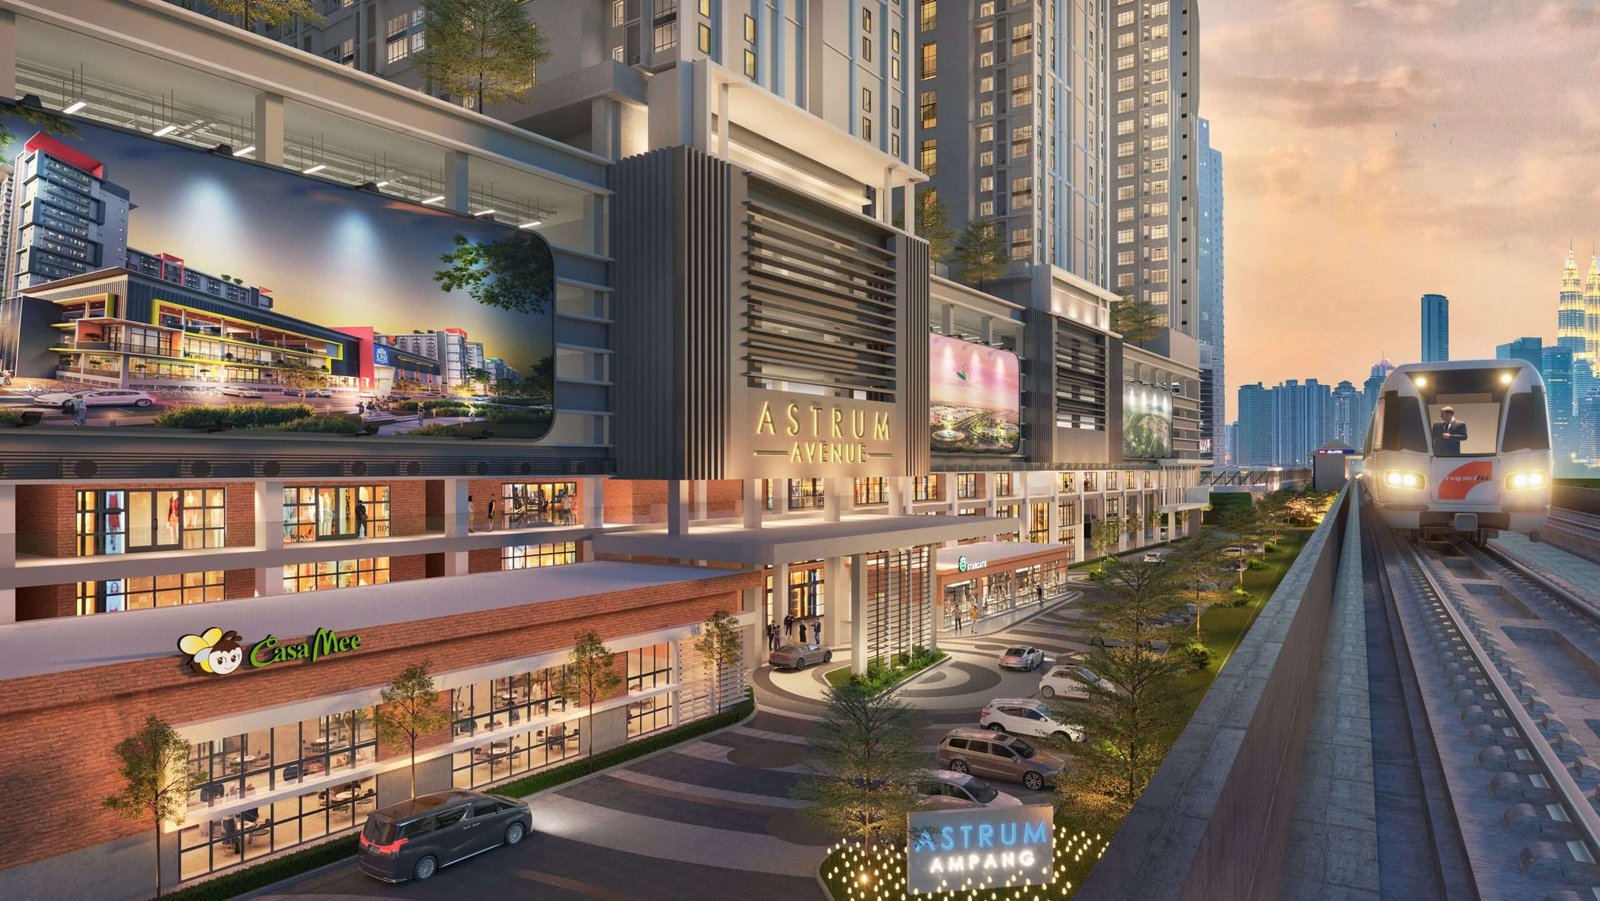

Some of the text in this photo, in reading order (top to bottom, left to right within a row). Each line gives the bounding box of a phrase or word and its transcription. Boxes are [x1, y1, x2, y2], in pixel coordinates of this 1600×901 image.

[756, 400, 891, 441] ASTRUM
[790, 440, 867, 464] AVENUE
[249, 627, 362, 668] Casa Mee
[914, 820, 1048, 853] ASTRUM
[929, 849, 1036, 874] AMPANG
